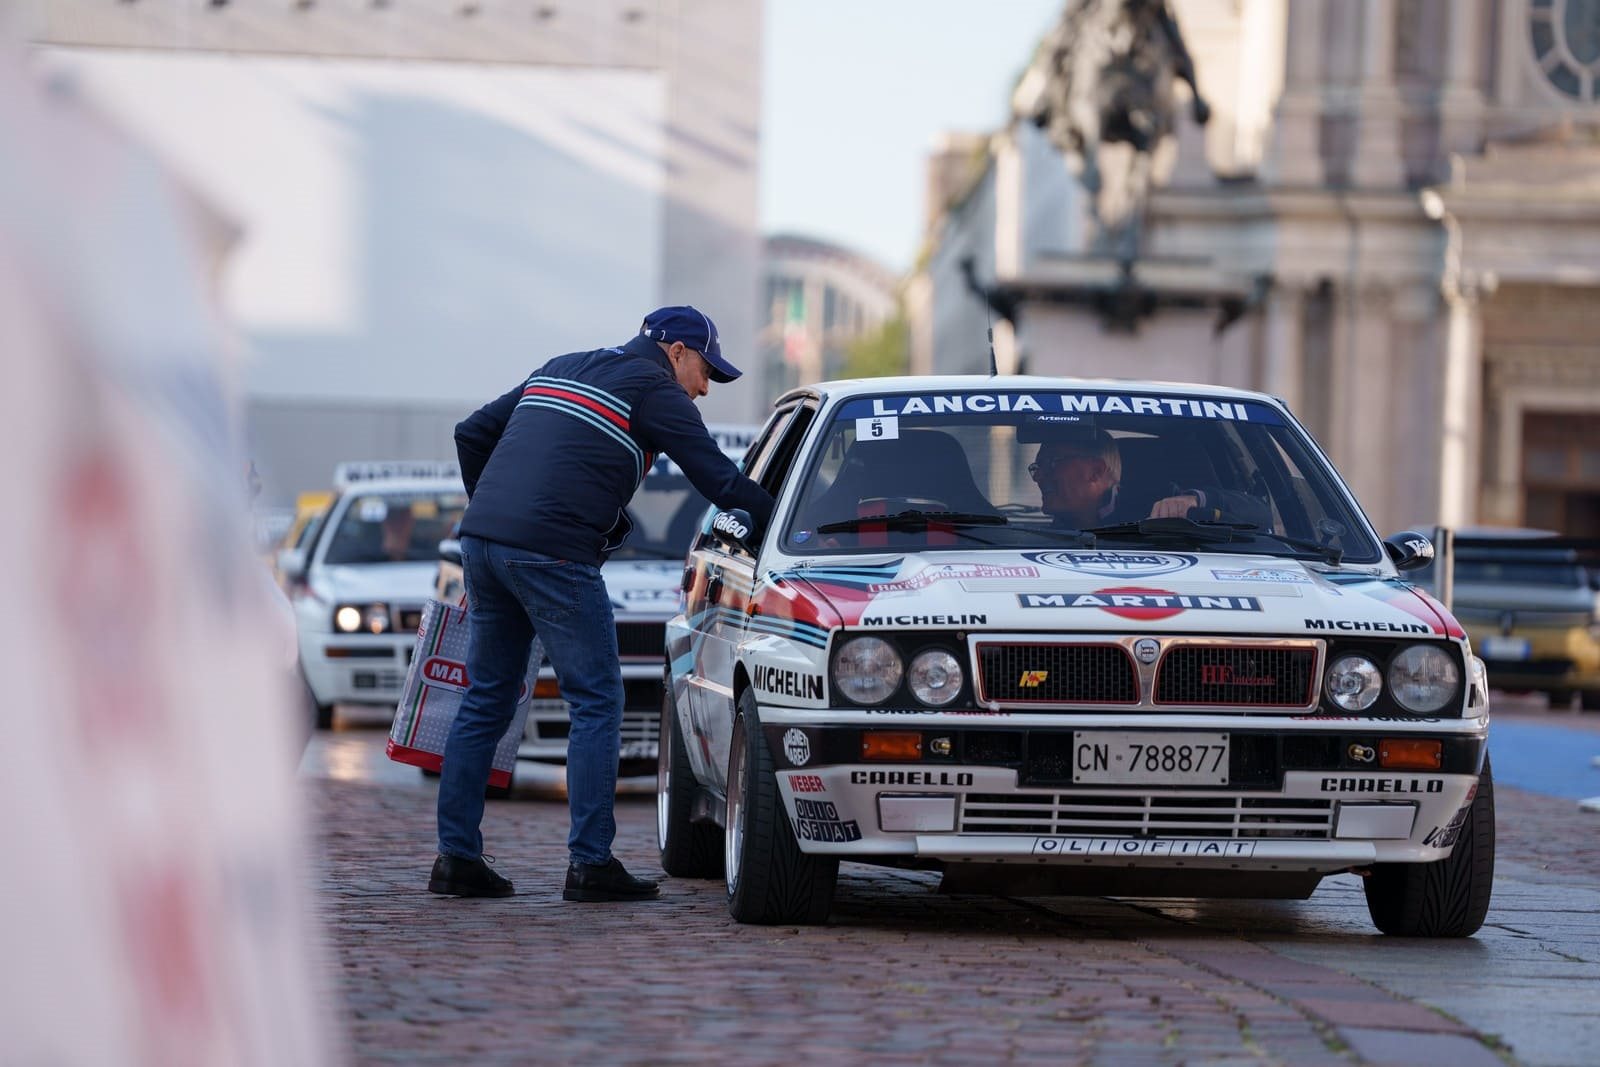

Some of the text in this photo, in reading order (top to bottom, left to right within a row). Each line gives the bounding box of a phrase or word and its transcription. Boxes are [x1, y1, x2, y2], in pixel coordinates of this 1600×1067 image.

[873, 395, 1249, 421] LANCIA MARTINI
[871, 422, 883, 437] 5
[1026, 595, 1253, 609] MARTINI
[863, 614, 987, 626] MICHELIN
[1304, 619, 1430, 634] MICHELIN
[753, 664, 824, 700] MICHELIN
[1076, 744, 1226, 772] CN 788877
[788, 775, 826, 792] WEBER
[851, 771, 973, 786] CARELLO
[1321, 778, 1443, 793] CARELLO
[796, 800, 837, 818] OLIO
